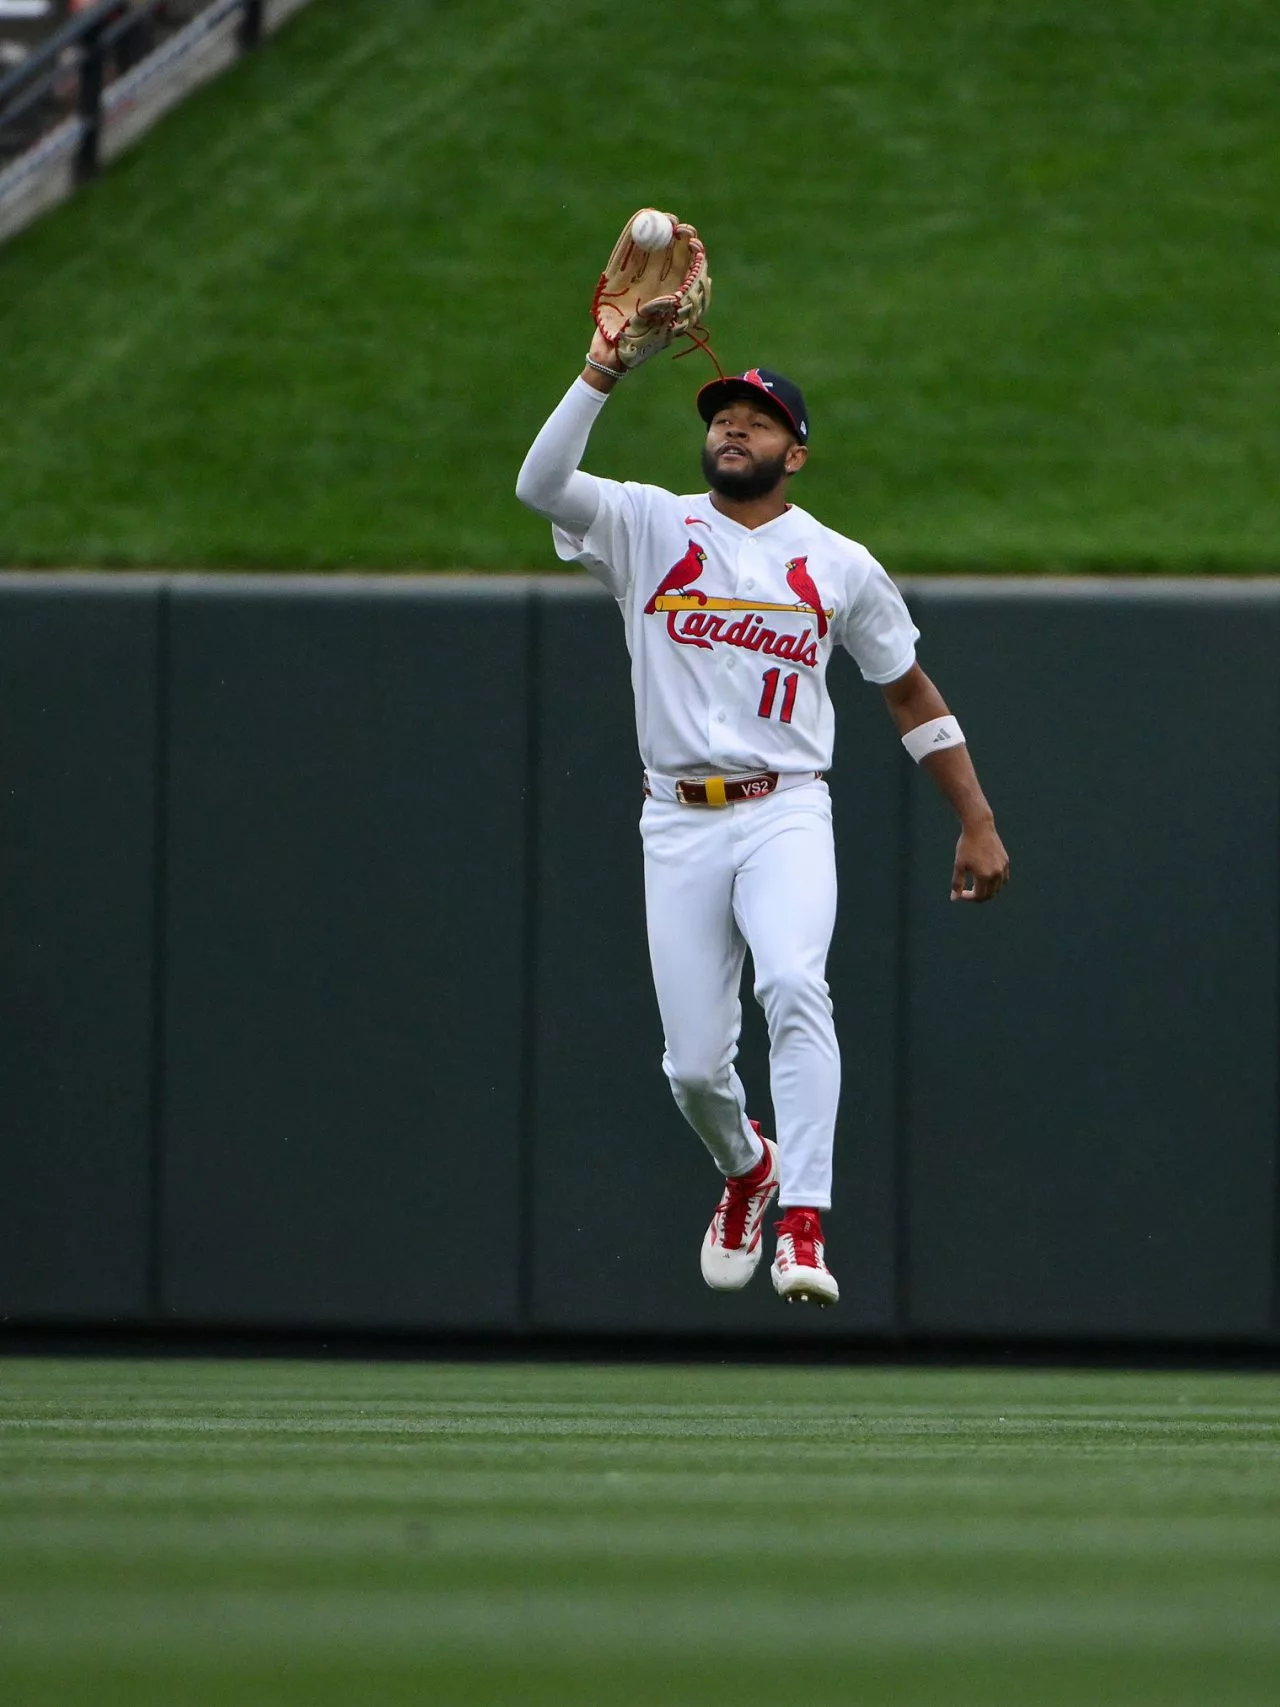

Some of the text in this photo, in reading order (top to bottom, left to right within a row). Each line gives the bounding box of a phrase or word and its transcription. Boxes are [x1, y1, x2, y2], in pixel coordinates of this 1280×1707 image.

[666, 588, 818, 668] Cardinals
[757, 667, 799, 724] 11
[741, 781, 769, 797] VS2
